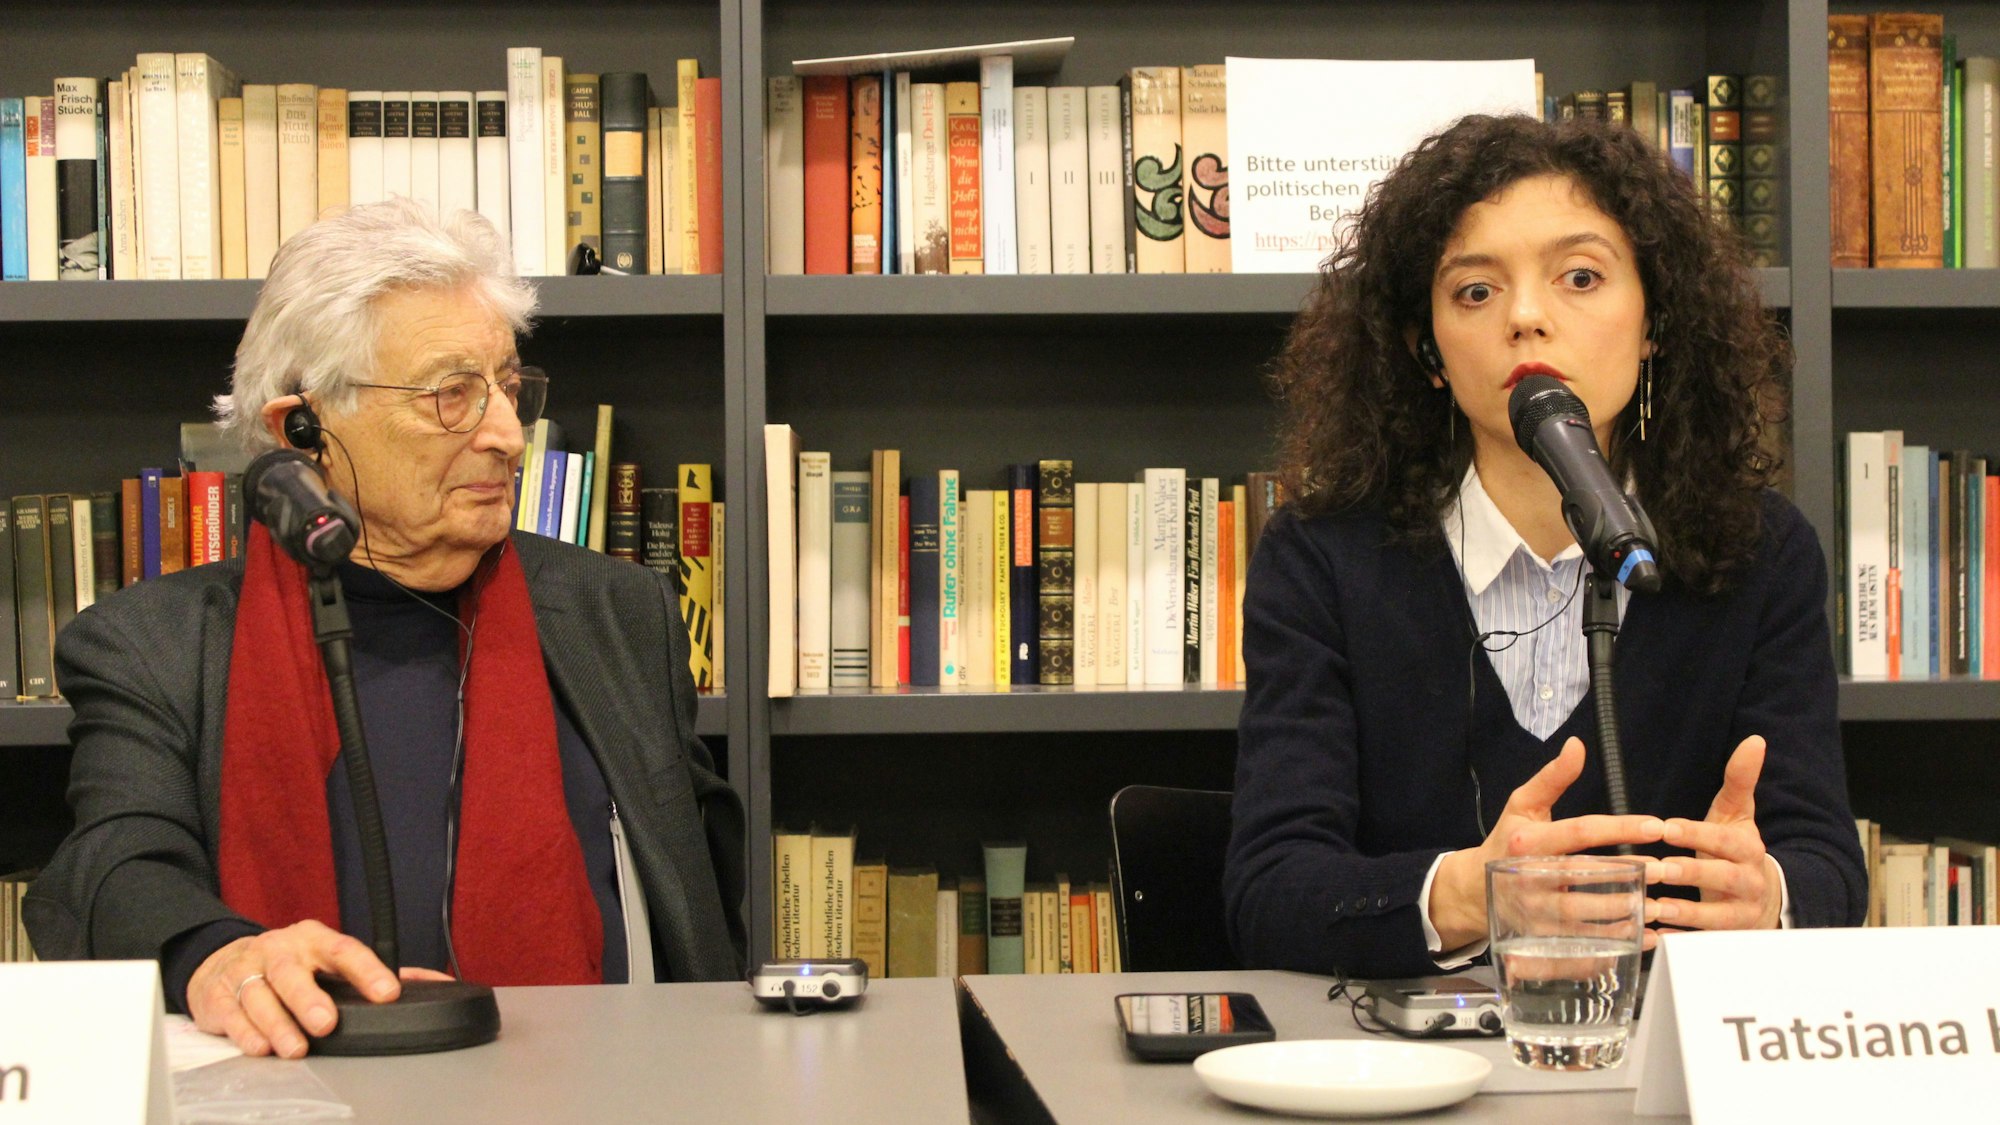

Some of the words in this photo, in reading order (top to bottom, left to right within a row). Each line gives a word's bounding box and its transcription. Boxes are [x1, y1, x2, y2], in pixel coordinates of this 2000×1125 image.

[57, 83, 78, 93] Max
[61, 94, 93, 104] Frisch
[58, 105, 93, 115] Stücke
[573, 110, 591, 118] BALL
[950, 119, 977, 132] KARL
[1025, 93, 1035, 141] SCHILLER
[1062, 93, 1072, 141] SCHILLER
[1100, 93, 1110, 141] SCHILLER
[922, 116, 935, 139] Das
[922, 142, 937, 206] Hagelstange
[950, 154, 978, 168] Wenn
[957, 169, 974, 185] die
[1247, 155, 1296, 172] Bitte
[1304, 155, 1402, 172] unterstüt
[1246, 180, 1360, 201] politischen
[954, 208, 979, 223] nung
[954, 221, 978, 236] nicht
[1255, 232, 1346, 252] https://po
[943, 477, 957, 526] Fahne
[1154, 477, 1167, 515] Walser
[1188, 488, 1201, 516] Pferd
[208, 484, 221, 563] ATSGRÜNDER
[1154, 515, 1167, 551] Martin
[1166, 526, 1178, 544] der
[1186, 516, 1200, 560] fliehendes
[647, 541, 659, 550] Die
[658, 541, 676, 550] Rose
[648, 550, 662, 558] und
[662, 550, 673, 558] der
[943, 530, 957, 570] ohne
[1186, 560, 1199, 580] Ein
[1868, 564, 1877, 596] OSTEN
[943, 573, 957, 618] Rufer
[1186, 581, 1200, 613] Walser
[1206, 573, 1215, 605] WALSER
[1858, 563, 1868, 643] VERTREIBUNG
[999, 591, 1007, 633] TUCHOLSKY
[1166, 614, 1178, 630] Die
[1206, 607, 1215, 641] MARTIN
[1869, 599, 1877, 621] DEM
[999, 633, 1007, 654] KURT
[1087, 613, 1096, 667] WAGGERL
[1113, 613, 1121, 667] WAGGERL
[1186, 612, 1200, 649] Martin
[1869, 622, 1878, 642] AUS
[958, 665, 967, 680] dtv
[782, 854, 791, 895] Tabellen
[825, 850, 834, 890] Tabellen
[792, 884, 801, 925] Literatur
[834, 879, 843, 920] Literatur
[782, 897, 792, 959] eschichtliche
[824, 893, 835, 959] geschichtliche
[791, 927, 800, 960] tschen
[801, 983, 818, 994] 152
[1722, 1010, 1970, 1063] Tatsiana
